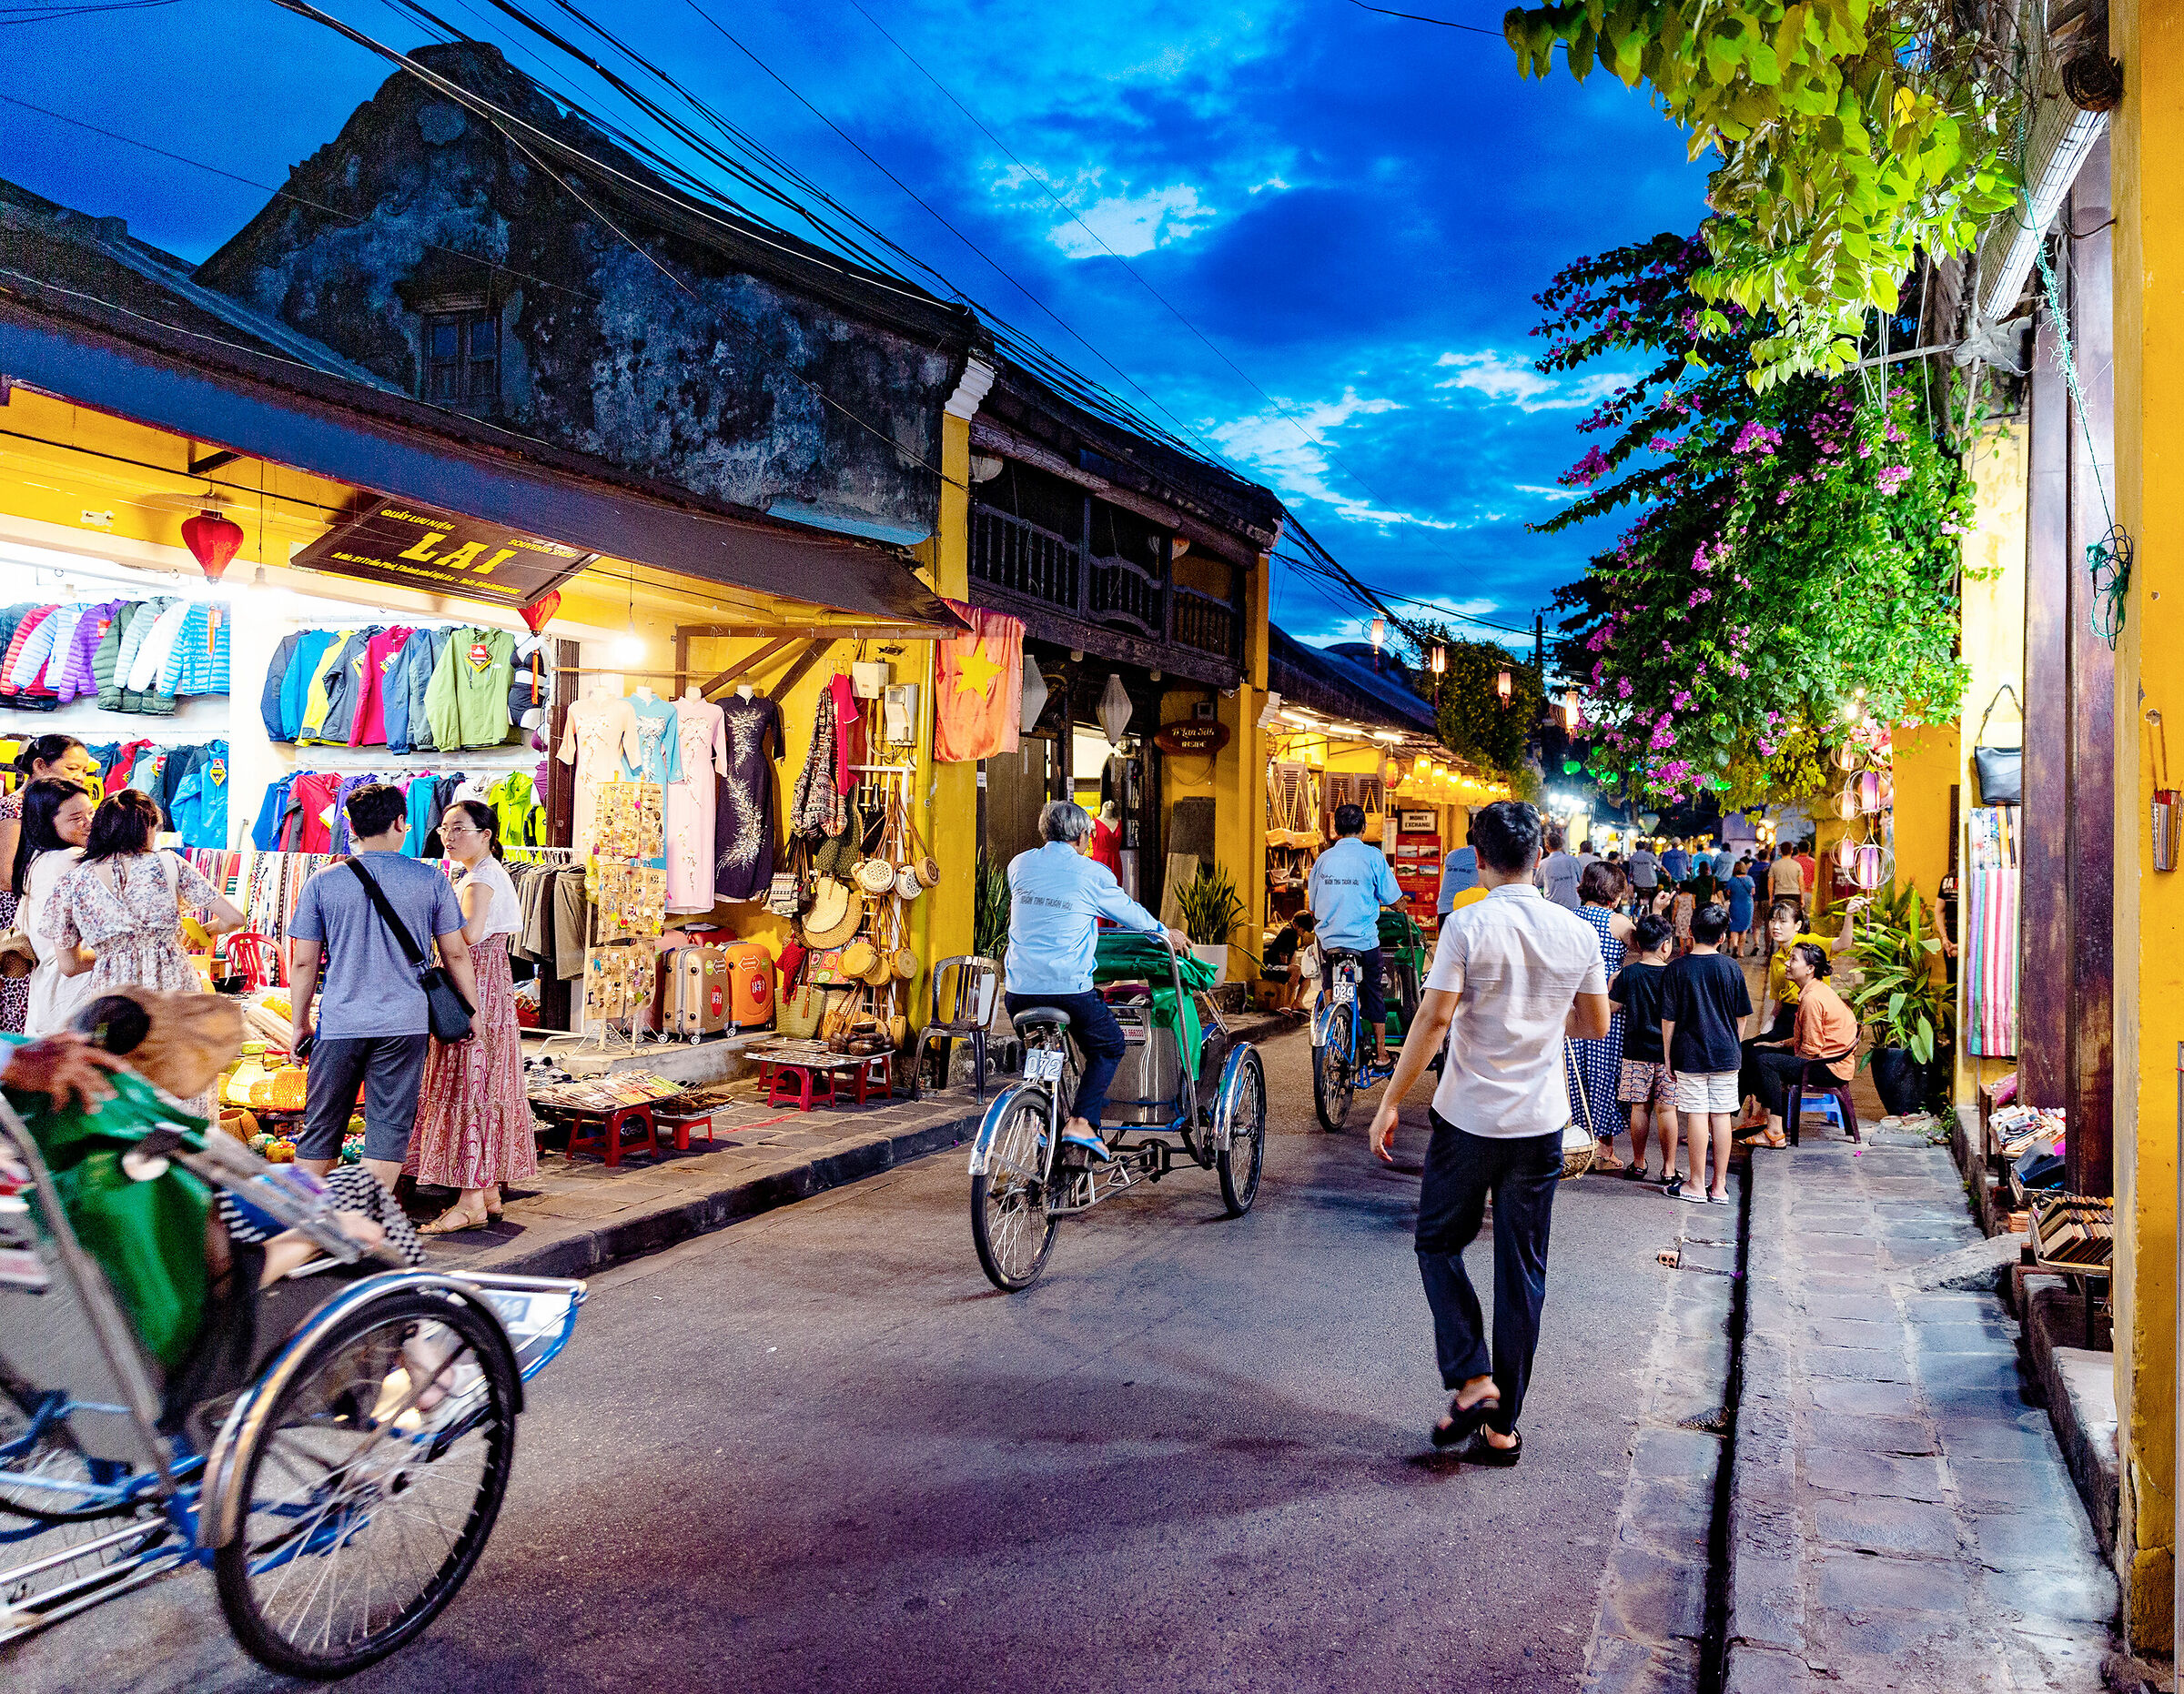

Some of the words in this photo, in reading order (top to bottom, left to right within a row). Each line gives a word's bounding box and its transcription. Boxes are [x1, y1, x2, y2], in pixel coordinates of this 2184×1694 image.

[398, 531, 518, 575] LAI
[550, 549, 577, 559] SHOP
[1333, 984, 1354, 998] 024
[1027, 1055, 1061, 1076] 072
